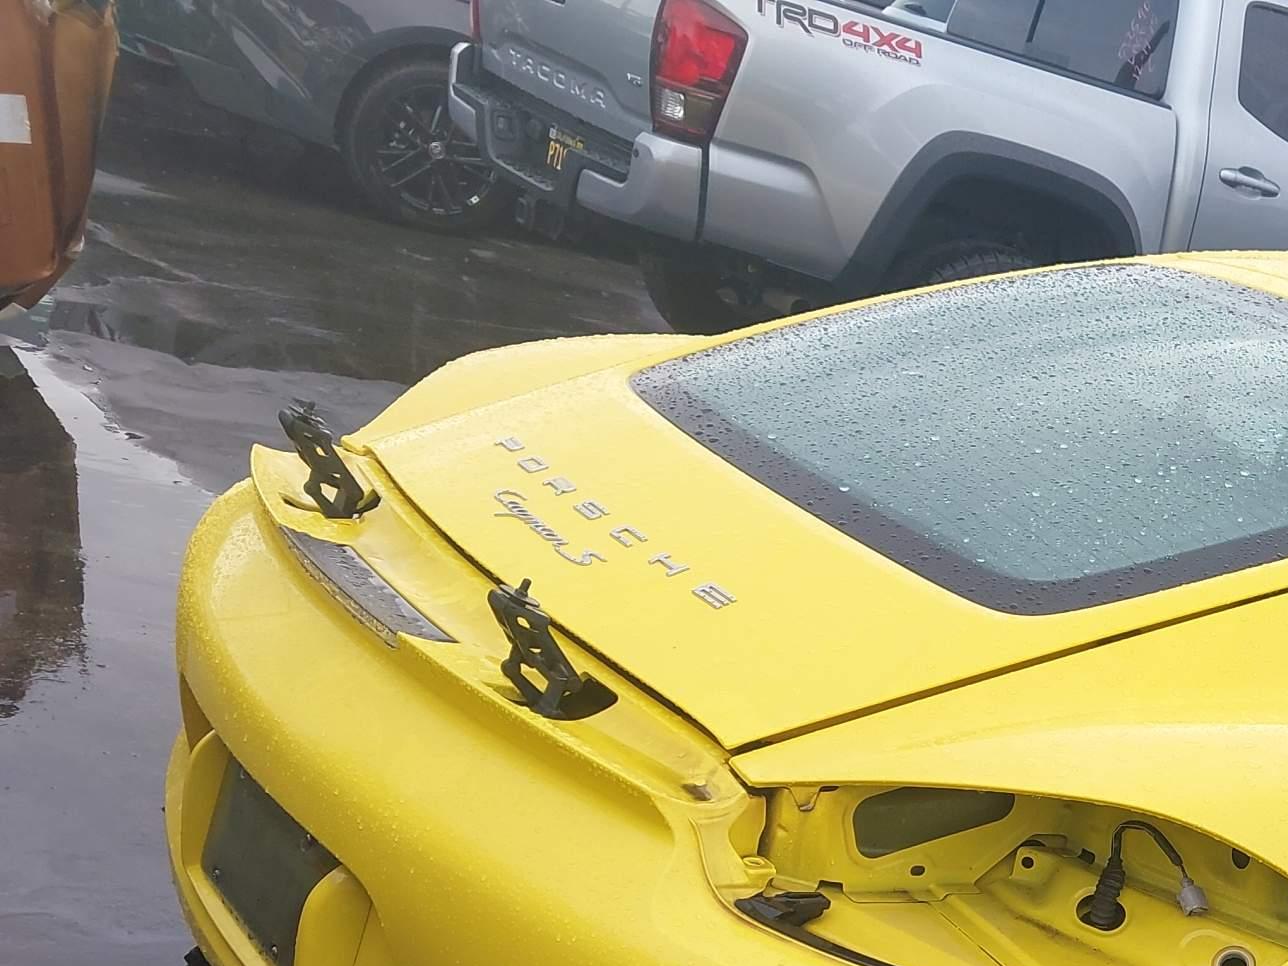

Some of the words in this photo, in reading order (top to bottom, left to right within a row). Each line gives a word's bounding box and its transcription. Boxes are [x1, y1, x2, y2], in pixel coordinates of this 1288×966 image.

[842, 20, 923, 58] 4X4
[842, 38, 876, 54] OFF
[876, 48, 922, 67] ROAD
[509, 48, 606, 109] TACOMA
[494, 436, 738, 610] PORSCHE
[494, 488, 569, 549] Cayman
[553, 548, 608, 567] S
